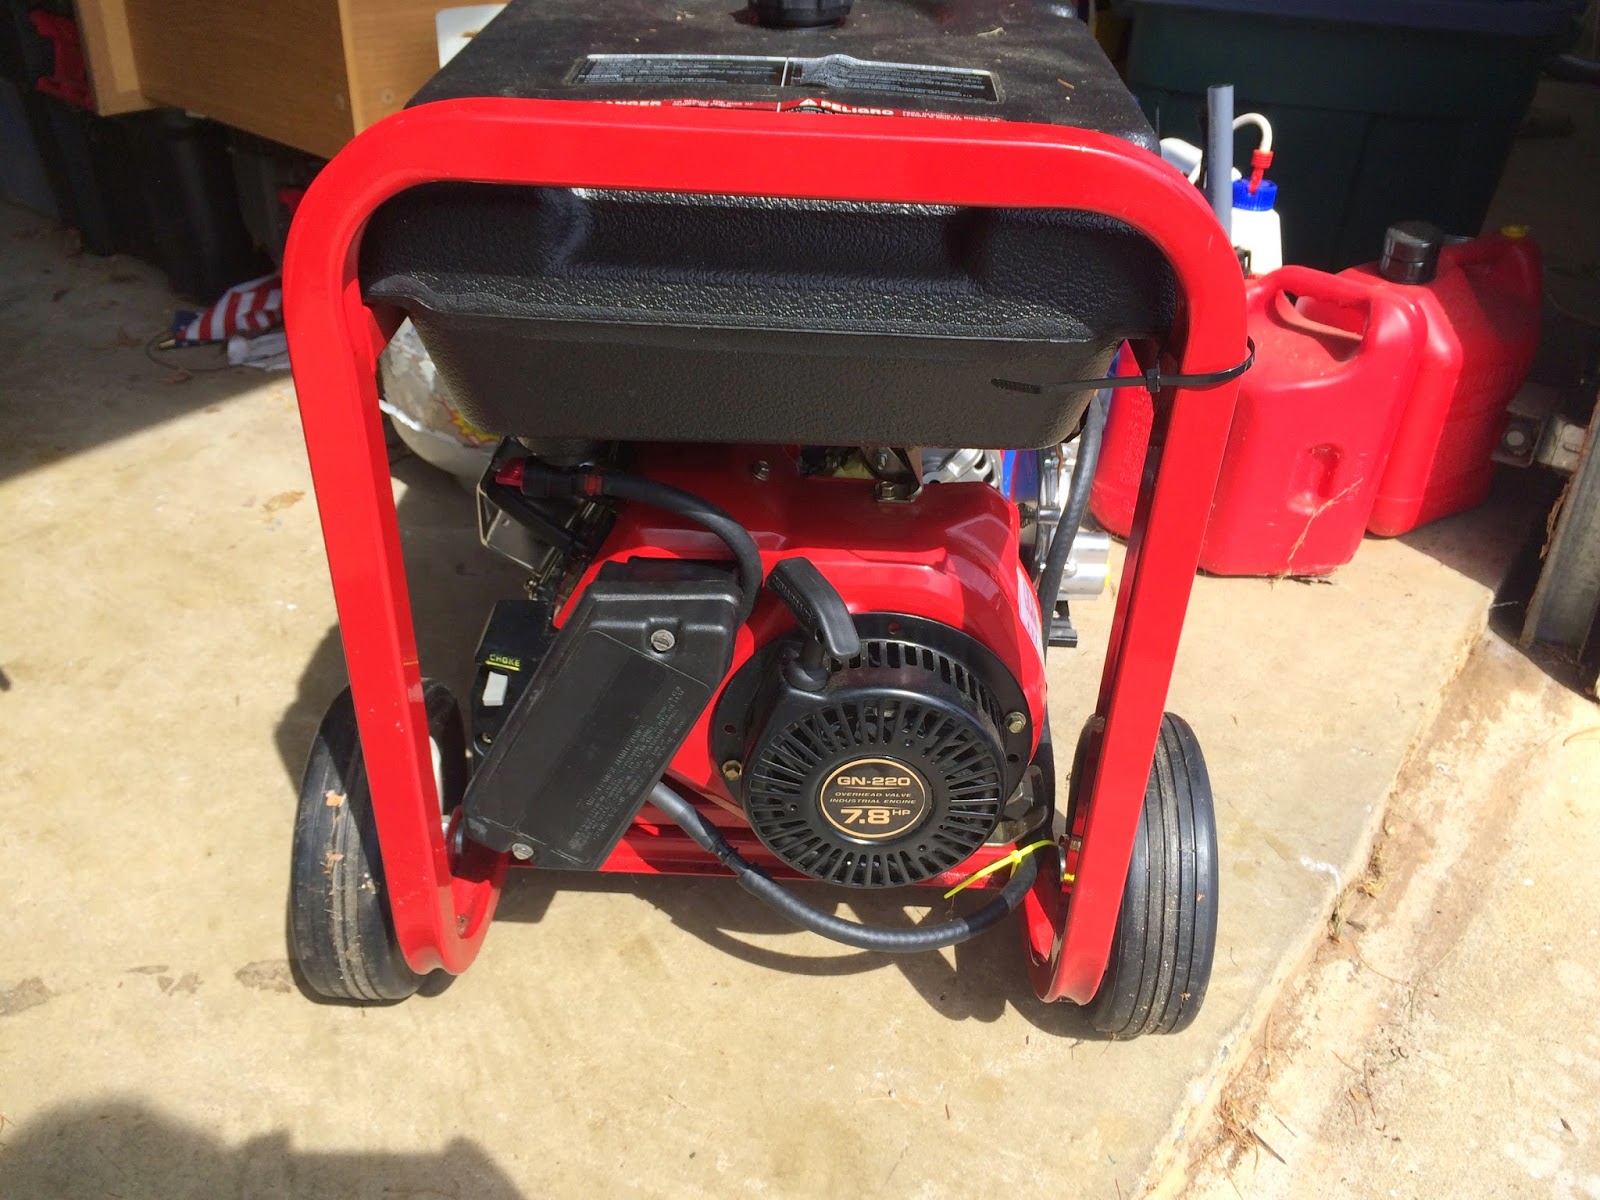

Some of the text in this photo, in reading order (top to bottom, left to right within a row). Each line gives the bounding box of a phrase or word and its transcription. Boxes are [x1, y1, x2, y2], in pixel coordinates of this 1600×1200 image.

[820, 100, 894, 115] PELIGRO
[489, 653, 520, 667] CHOKE
[837, 776, 911, 786] GN-220
[840, 809, 890, 825] 7.8
